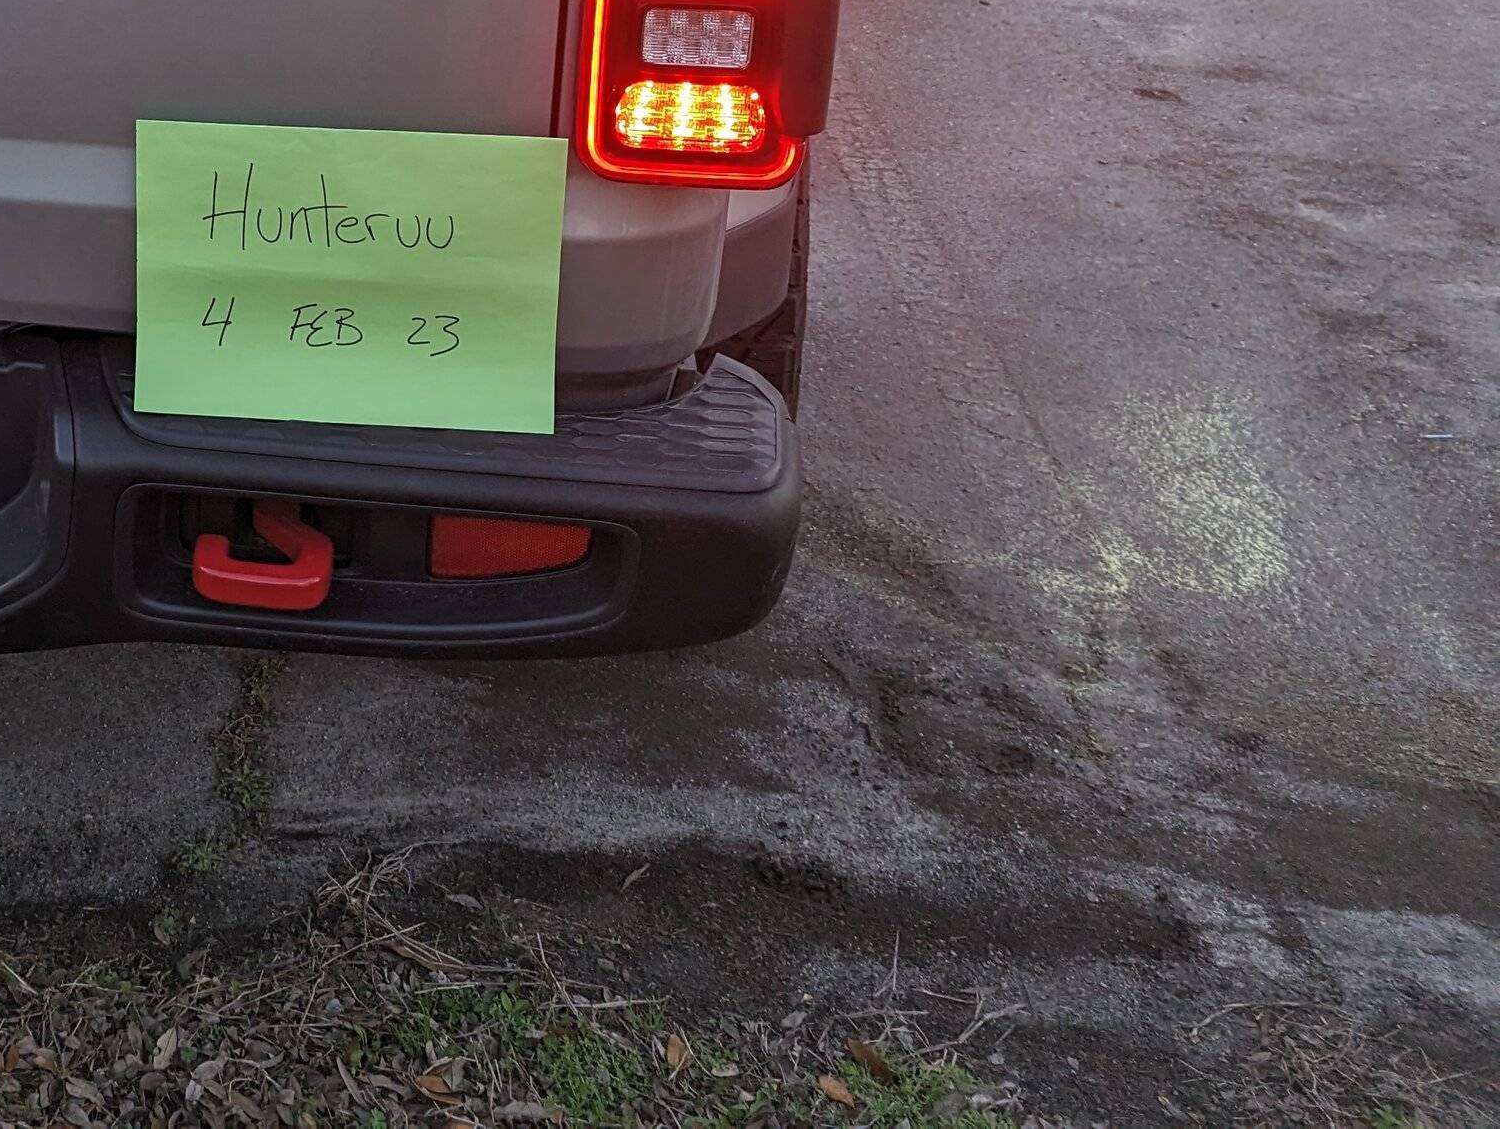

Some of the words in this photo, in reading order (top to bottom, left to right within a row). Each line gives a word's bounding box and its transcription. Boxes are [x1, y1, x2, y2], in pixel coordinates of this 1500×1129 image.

[202, 297, 235, 347] 4
[290, 303, 363, 347] FEB
[407, 315, 460, 357] 23
